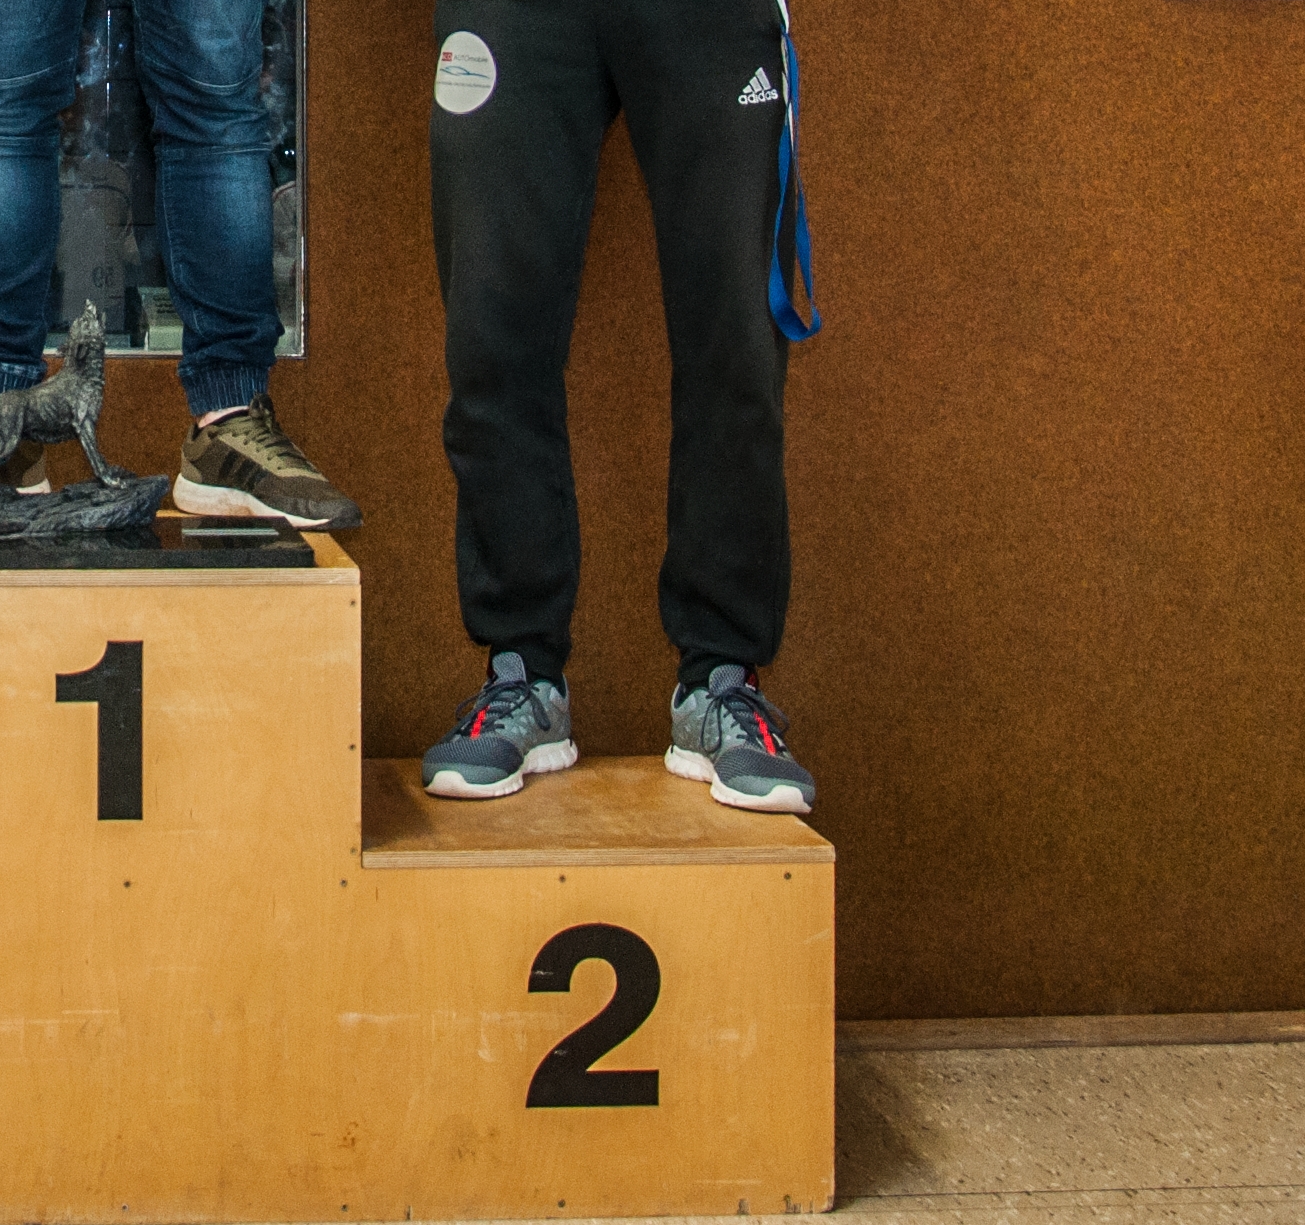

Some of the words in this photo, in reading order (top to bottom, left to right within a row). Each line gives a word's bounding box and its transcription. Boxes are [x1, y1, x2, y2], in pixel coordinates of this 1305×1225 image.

[738, 88, 779, 105] adidas
[56, 641, 144, 822] 1
[525, 923, 663, 1110] 2
